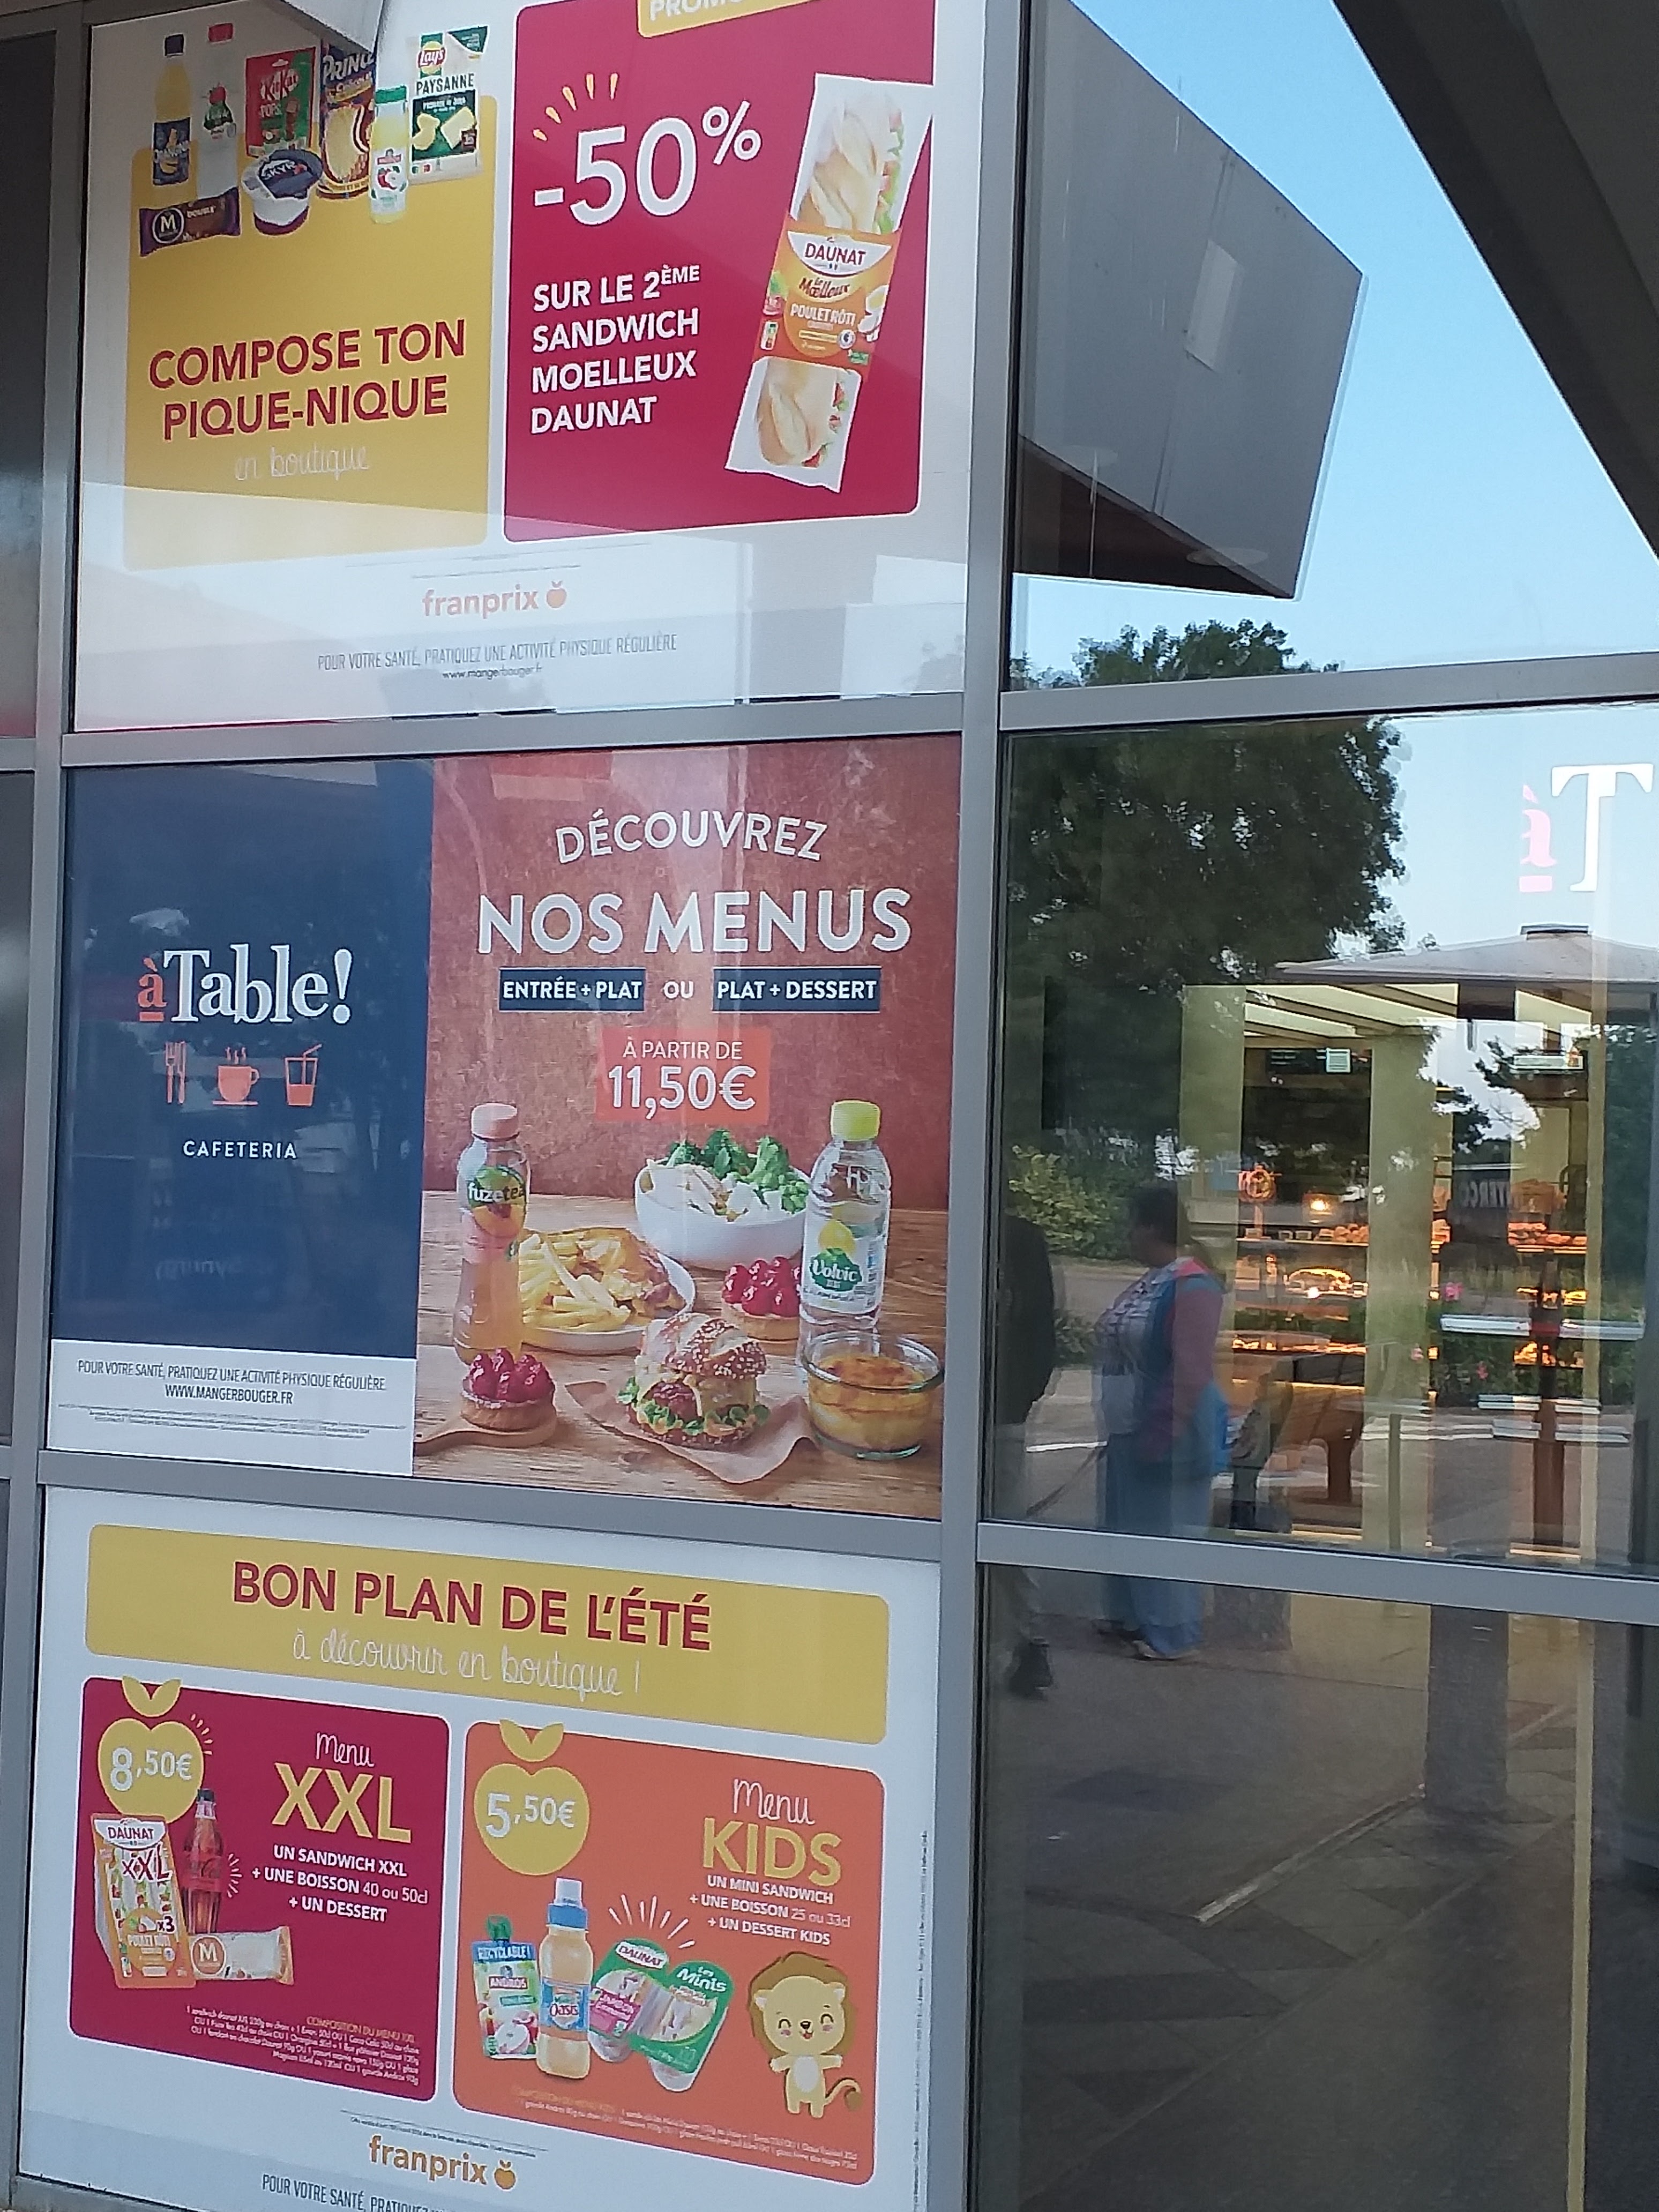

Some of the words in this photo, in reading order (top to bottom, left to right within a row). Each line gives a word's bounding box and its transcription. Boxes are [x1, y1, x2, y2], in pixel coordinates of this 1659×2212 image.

[416, 73, 475, 95] PAYSANNE
[261, 160, 295, 181] SKYR
[161, 215, 176, 233] M
[804, 242, 866, 266] DAUNAT
[534, 280, 591, 312] SUR
[600, 274, 633, 303] LE
[790, 303, 830, 323] POULET
[533, 308, 699, 353] SANDWICH
[149, 329, 361, 390] COMPOSE
[374, 318, 466, 365] TON
[530, 350, 697, 394] MOELLEUX
[163, 374, 448, 442] PIQUE-NIQUE
[530, 395, 657, 435] DAUNAT
[271, 442, 370, 481] boutique
[422, 583, 540, 619] franprix
[318, 654, 346, 671] POUR
[348, 652, 382, 670] VOTRE
[424, 646, 482, 665] PRATIQUEZ
[484, 645, 507, 662] UNE
[510, 637, 556, 660] ACTIVITÉ
[559, 637, 612, 657] PHYSIQUE
[616, 630, 678, 653] RÉGULIÈRE
[555, 807, 828, 864] DÉCOUVREZ
[478, 893, 624, 954] NOS
[644, 887, 913, 953] MENUS
[503, 976, 577, 1000] ENTRÉE
[595, 981, 644, 1000] PLAT
[663, 981, 694, 1000] OU
[716, 981, 766, 1000] PLAT
[785, 981, 877, 1000] DESSERT
[623, 1035, 638, 1059] À
[642, 1041, 711, 1060] PARTIR
[716, 1040, 743, 1059] DE
[609, 1065, 757, 1120] 11,50€
[183, 1140, 297, 1159] CAFETERIA
[811, 1259, 858, 1282] Volvic
[78, 1359, 104, 1374] POUR
[105, 1362, 134, 1376] VOTRE
[135, 1362, 165, 1380] SANTÉ,
[168, 1365, 218, 1381] PRATIQUEZ
[220, 1369, 241, 1382] UNE
[241, 1369, 280, 1384] ACTIVITÉ
[282, 1372, 331, 1388] PHYSIQUE
[333, 1373, 386, 1391] RÉGULIÈRE
[165, 1384, 293, 1404] WWW.MANGERBOUGER.FR
[233, 1561, 337, 1612] BON
[354, 1571, 482, 1626] PLAN
[501, 1585, 568, 1636] DE
[586, 1586, 711, 1651] L'ÉTÉ
[293, 1628, 311, 1661] à
[321, 1628, 448, 1676] découvrir
[458, 1648, 491, 1680] en
[501, 1643, 624, 1702] boutique
[315, 1732, 374, 1768] Menu
[109, 1746, 193, 1791] 8,50€
[271, 1761, 412, 1844] XXL
[485, 1792, 577, 1839] 5,50€
[733, 1777, 816, 1826] Menu
[107, 1826, 154, 1840] DAUNAT
[122, 1844, 173, 1881] XXL
[273, 1844, 295, 1860] UN
[298, 1847, 376, 1872] SANDWICH
[378, 1860, 407, 1877] XXL
[703, 1817, 842, 1887] KIDS
[264, 1866, 294, 1884] UNE
[297, 1871, 360, 1894] BOISSON
[362, 1881, 379, 1897] 40
[382, 1888, 399, 1900] ou
[401, 1886, 428, 1904] 50cl
[707, 1874, 727, 1889] UN
[729, 1877, 760, 1894] MINI
[762, 1882, 834, 1905] SANDWICH
[157, 1915, 175, 1933] x3
[301, 1895, 323, 1912] UN
[326, 1900, 388, 1923] DESSERT
[700, 1893, 729, 1909] UNE
[731, 1898, 789, 1918] BOISSON
[791, 1907, 806, 1922] 25
[809, 1913, 824, 1924] ou
[719, 1916, 739, 1931] UN
[742, 1920, 797, 1940] DESSERT
[799, 1929, 831, 1946] KIDS
[199, 1942, 218, 1963] M
[618, 1945, 664, 1966] DAUNAT
[489, 1977, 527, 1989] ANDROS
[676, 1967, 728, 1992] Minis
[549, 2003, 579, 2017] Oasis
[368, 2134, 488, 2186] franprix
[262, 2173, 291, 2195] POUR
[293, 2179, 327, 2203] VOTRE
